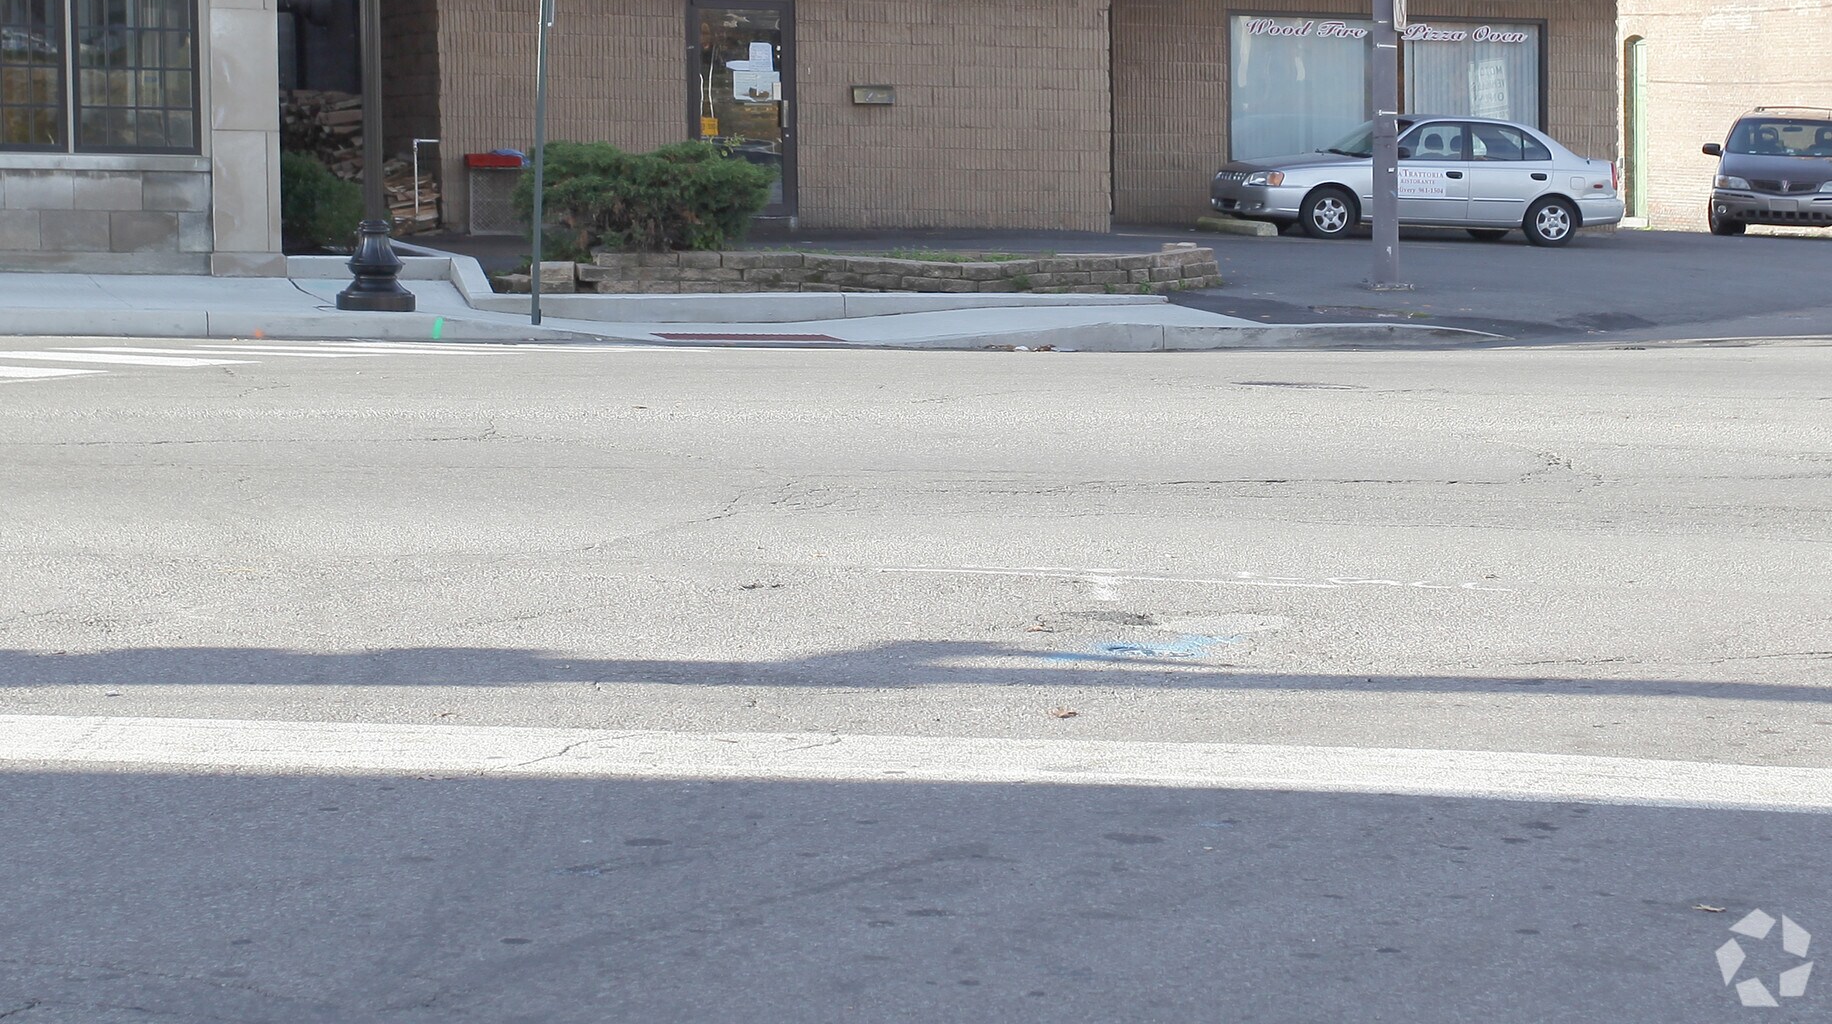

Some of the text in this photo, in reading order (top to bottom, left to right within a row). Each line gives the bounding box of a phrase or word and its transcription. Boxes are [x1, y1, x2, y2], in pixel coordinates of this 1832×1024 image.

[1246, 19, 1529, 44] Wood Fire Pizza Oven
